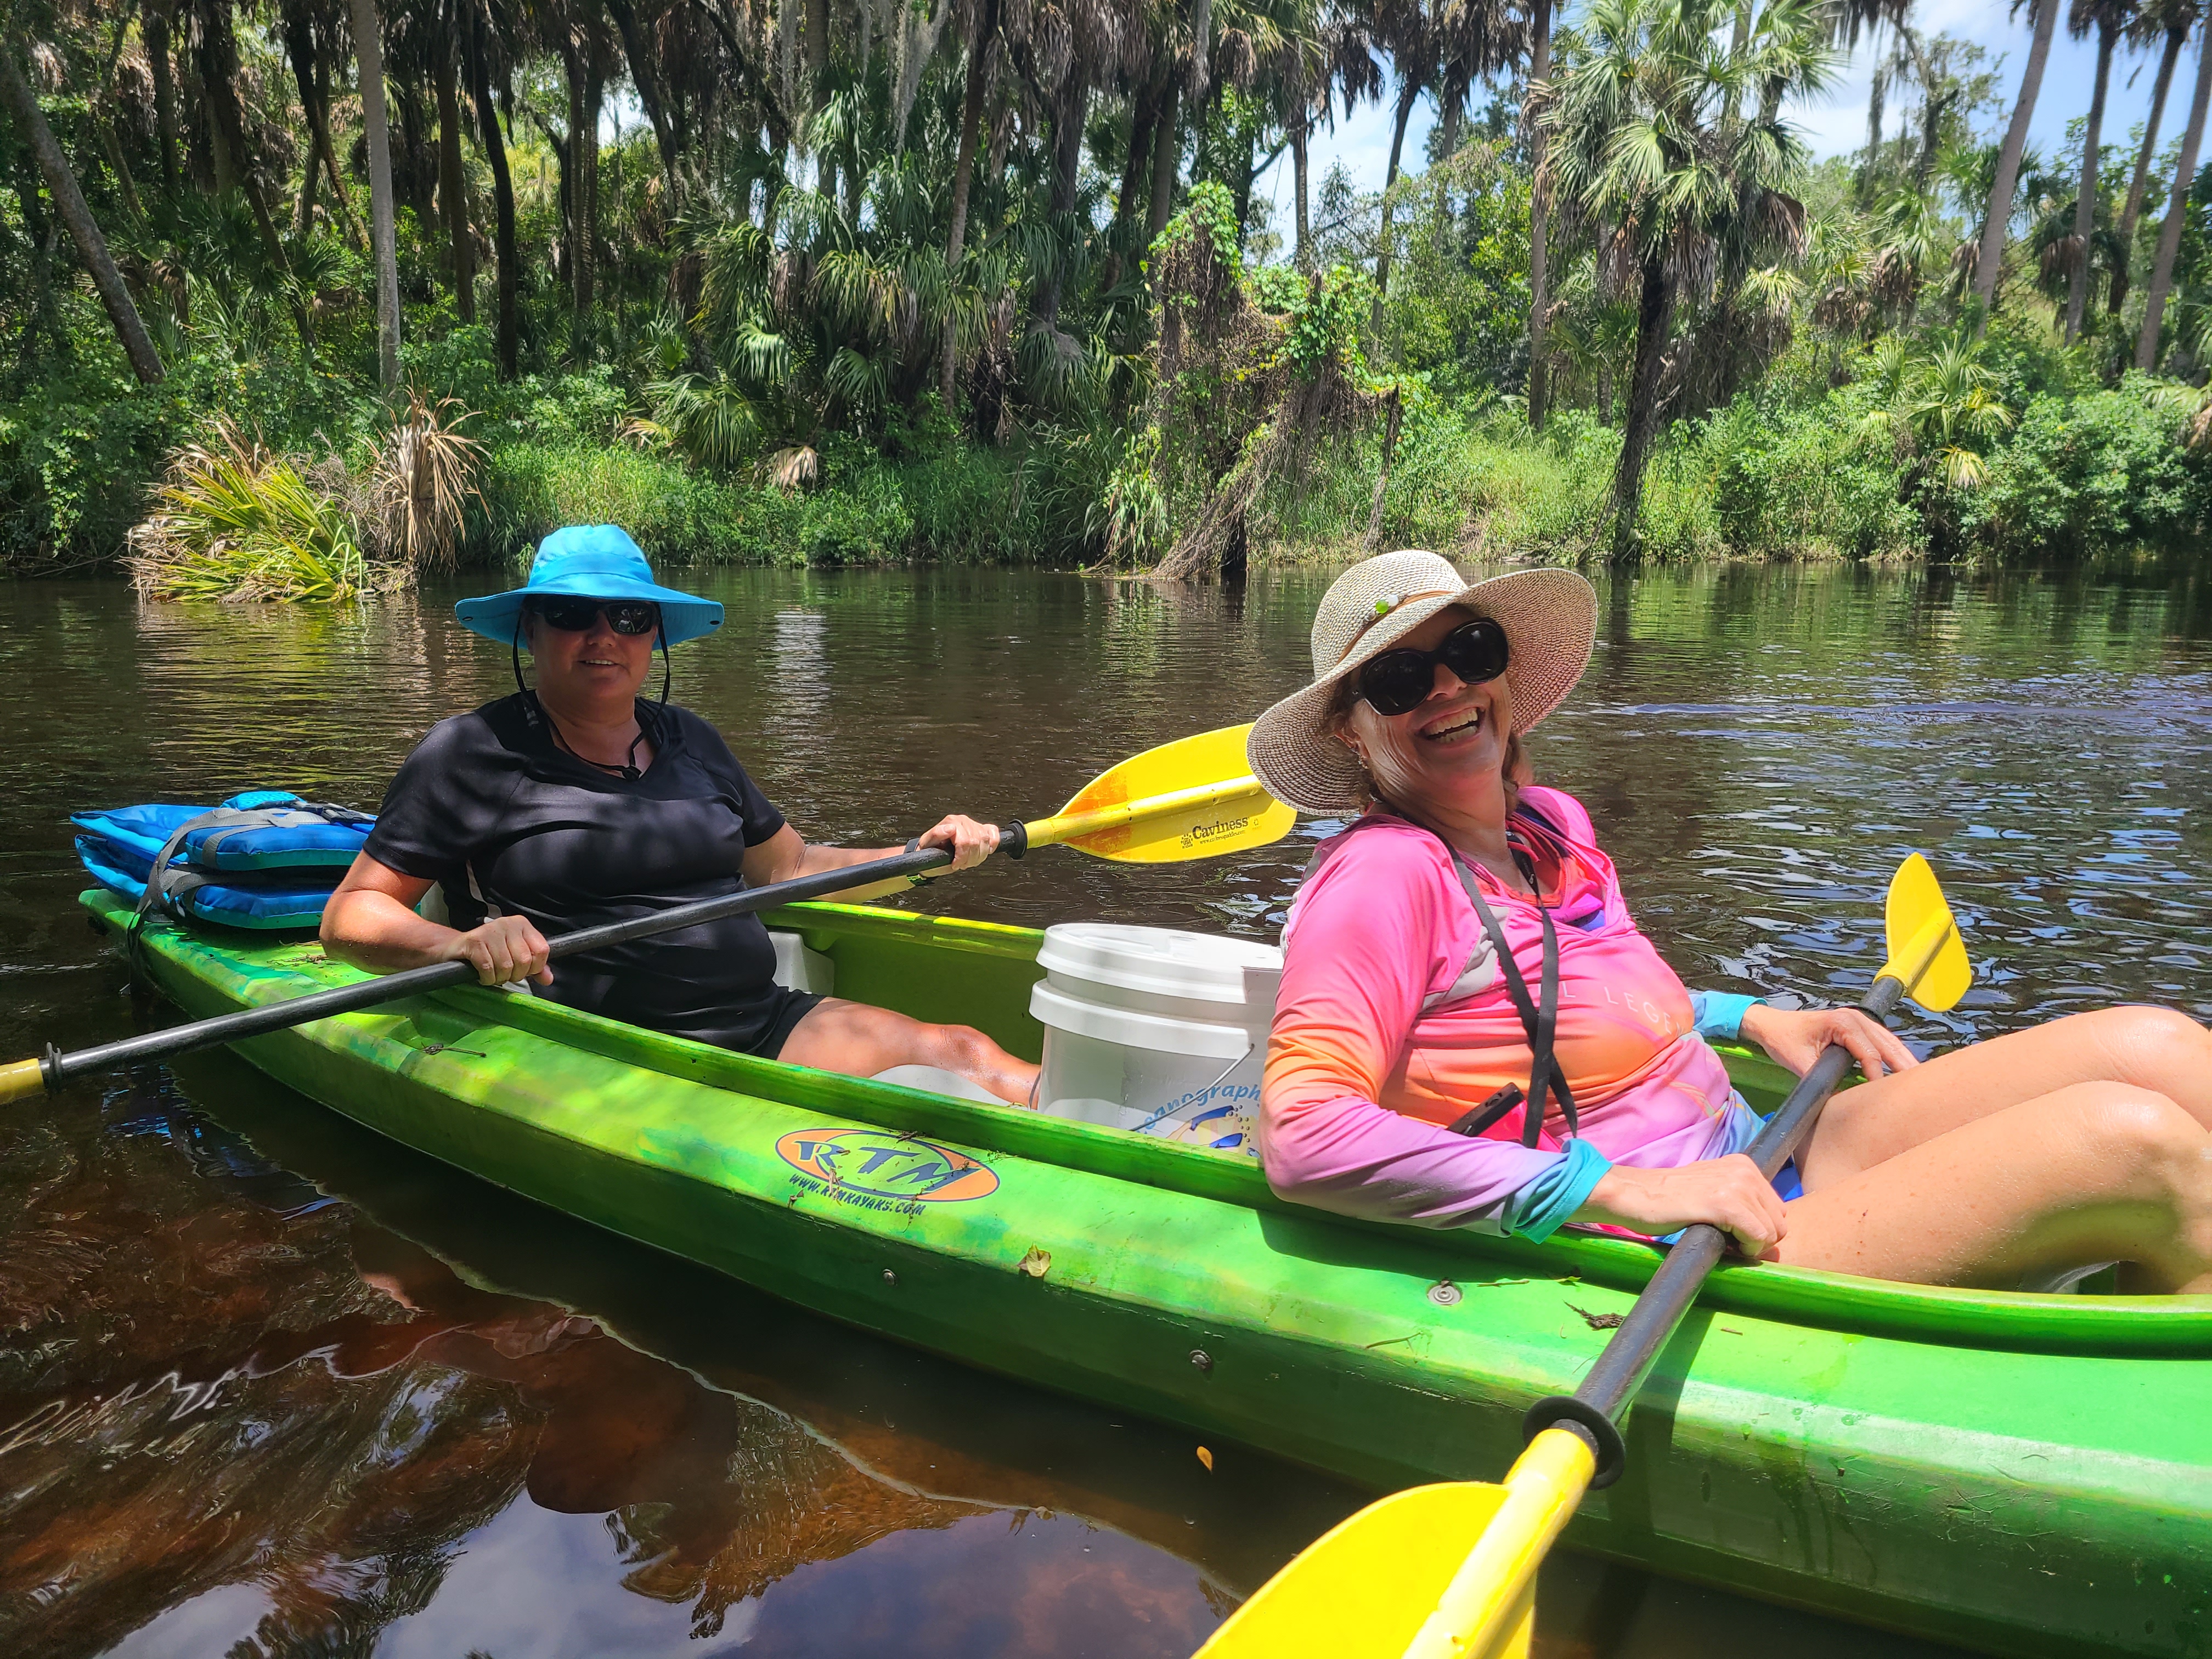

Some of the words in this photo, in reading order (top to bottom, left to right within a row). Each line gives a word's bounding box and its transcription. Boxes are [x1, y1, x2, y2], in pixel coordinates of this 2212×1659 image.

[1192, 816, 1249, 839] Caviness
[1135, 1084, 1261, 1134] eanograph
[794, 1140, 980, 1192] RTM
